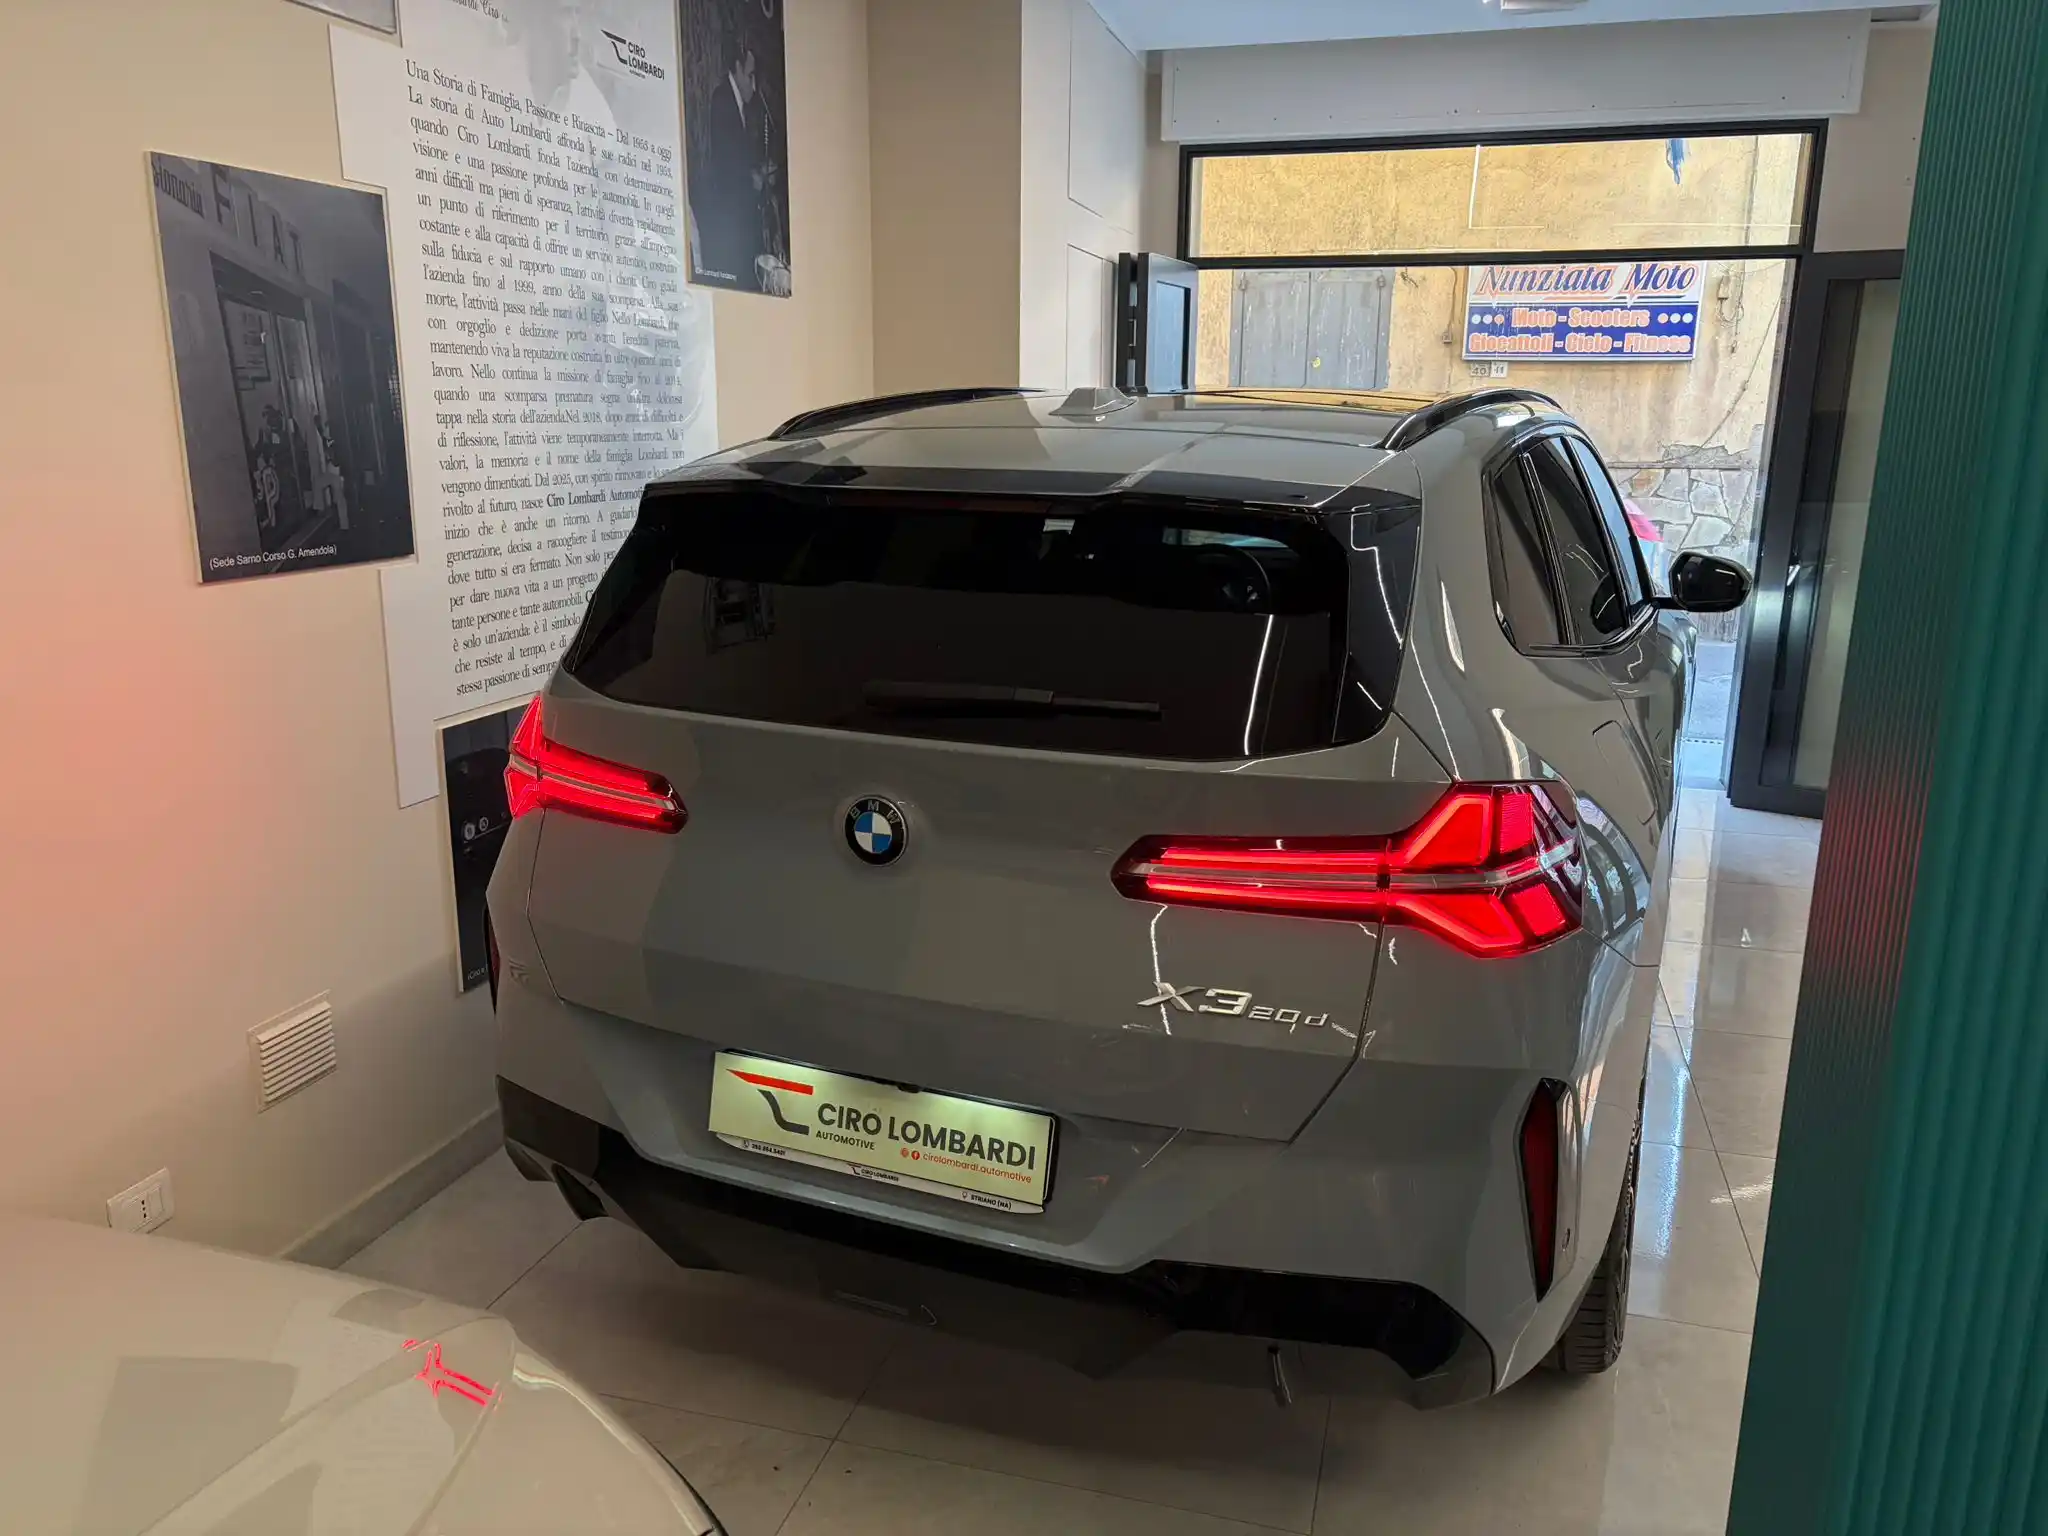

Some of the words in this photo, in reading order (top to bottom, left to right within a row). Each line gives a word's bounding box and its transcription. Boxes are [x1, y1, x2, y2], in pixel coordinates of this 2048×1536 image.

[628, 42, 646, 58] CIRO
[629, 55, 665, 80] LOMBARDI
[406, 59, 429, 83] Una
[433, 68, 463, 94] Storia
[467, 79, 477, 98] di
[481, 84, 522, 114] Famiglia,
[526, 98, 561, 124] Passione
[408, 85, 423, 106] La
[430, 97, 458, 117] storia
[464, 102, 474, 121] di
[481, 107, 505, 130] Auto
[510, 116, 552, 144] Lombardi
[410, 117, 449, 138] quando
[457, 125, 479, 147] Ciro
[487, 133, 531, 160] Lombardi
[538, 147, 560, 168] fonda
[413, 140, 449, 163] visione
[467, 156, 485, 172] una
[491, 162, 528, 182] passione
[533, 172, 568, 192] profonda
[415, 168, 438, 185] anni
[442, 170, 474, 193] difficili
[479, 183, 494, 197] ma
[499, 185, 520, 204] pieni
[523, 189, 533, 206] di
[418, 194, 432, 208] un
[439, 198, 469, 215] punto
[475, 201, 485, 218] di
[492, 206, 539, 229] riferimento
[545, 220, 558, 235] per
[419, 219, 460, 237] costante
[475, 225, 491, 243] alla
[495, 233, 529, 250] capacità
[533, 235, 541, 252] di
[422, 241, 445, 259] sulla
[451, 244, 482, 264] fiducia
[500, 254, 513, 269] sul
[519, 260, 555, 277] rapporto
[423, 264, 465, 285] l'azienda
[472, 271, 491, 289] fino
[497, 275, 506, 291] al
[514, 281, 536, 297] 1999,
[542, 285, 562, 298] anno
[1477, 264, 1613, 293] Nunziata
[1623, 262, 1697, 291] Moto
[426, 293, 458, 310] morte,
[462, 293, 499, 312] l'attività
[503, 302, 526, 317] passa
[530, 302, 549, 318] nelle
[1511, 308, 1557, 328] Moto
[1568, 307, 1650, 328] Scooters
[427, 317, 446, 330] con
[456, 318, 497, 338] orgoglio
[519, 322, 559, 340] dedizione
[1469, 332, 1555, 353] Giocattoli
[1565, 332, 1612, 353] Ciclo
[1623, 332, 1691, 353] Fitness
[430, 341, 489, 356] mantenendo
[491, 343, 510, 358] viva
[512, 343, 520, 359] la
[523, 347, 568, 364] reputazione
[432, 361, 463, 378] lavoro.
[471, 363, 496, 379] Nello
[502, 367, 538, 381] continua
[544, 367, 552, 382] la
[434, 385, 470, 405] quando
[479, 391, 496, 402] una
[504, 392, 547, 406] scomparsa
[436, 411, 462, 428] tappa
[467, 409, 488, 424] nella
[492, 410, 516, 424] storia
[437, 432, 447, 447] di
[453, 432, 499, 448] riflessione,
[504, 431, 537, 446] l'attività
[439, 455, 468, 472] valori,
[475, 454, 484, 469] la
[491, 454, 529, 468] memoria
[546, 452, 552, 466] il
[441, 481, 482, 497] vengono
[483, 475, 531, 491] dimenticati.
[535, 473, 550, 488] Dal
[552, 475, 573, 488] 2025,
[443, 500, 474, 517] rivolto
[477, 498, 486, 514] al
[489, 498, 517, 513] futuro,
[521, 498, 544, 510] nasce
[546, 494, 565, 508] Ciro
[444, 523, 470, 539] inizio
[478, 520, 494, 536] che
[501, 519, 507, 533] è
[514, 516, 538, 532] anche
[545, 518, 556, 529] un
[209, 557, 235, 570] (Sede
[263, 551, 287, 562] Corso
[287, 549, 297, 559] G.
[298, 544, 337, 558] Amendola)
[446, 543, 502, 566] generazione,
[507, 539, 532, 554] decisa
[547, 532, 587, 550] raccogliere
[447, 569, 470, 584] dove
[475, 567, 497, 580] tutto
[501, 562, 508, 576] si
[512, 563, 526, 575] era
[529, 558, 561, 572] fermato.
[565, 553, 582, 567] Non
[449, 594, 465, 611] per
[469, 588, 490, 603] dare
[494, 585, 520, 599] nuova
[524, 580, 540, 594] vita
[552, 578, 563, 589] un
[451, 614, 475, 629] tante
[477, 608, 511, 628] persone
[520, 602, 540, 616] tante
[542, 592, 583, 611] automobili.
[452, 636, 459, 651] è
[463, 632, 481, 648] solo
[485, 623, 530, 644] un'azienda:
[533, 620, 539, 633] è
[542, 617, 548, 632] il
[551, 612, 580, 630] simbolo
[454, 656, 471, 672] che
[475, 651, 503, 667] resiste
[507, 645, 515, 660] al
[519, 642, 546, 657] tempo,
[558, 634, 566, 648] di
[456, 678, 482, 694] stessa
[484, 668, 520, 690] passione
[521, 663, 530, 677] di
[850, 799, 901, 825] BMW
[1136, 981, 1253, 1016] X3
[815, 1130, 876, 1151] AUTOMOTIVE
[817, 1102, 882, 1136] CIRO
[888, 1116, 1036, 1170] LOMBARDI
[923, 1152, 1032, 1183] cirolombardi.automotive
